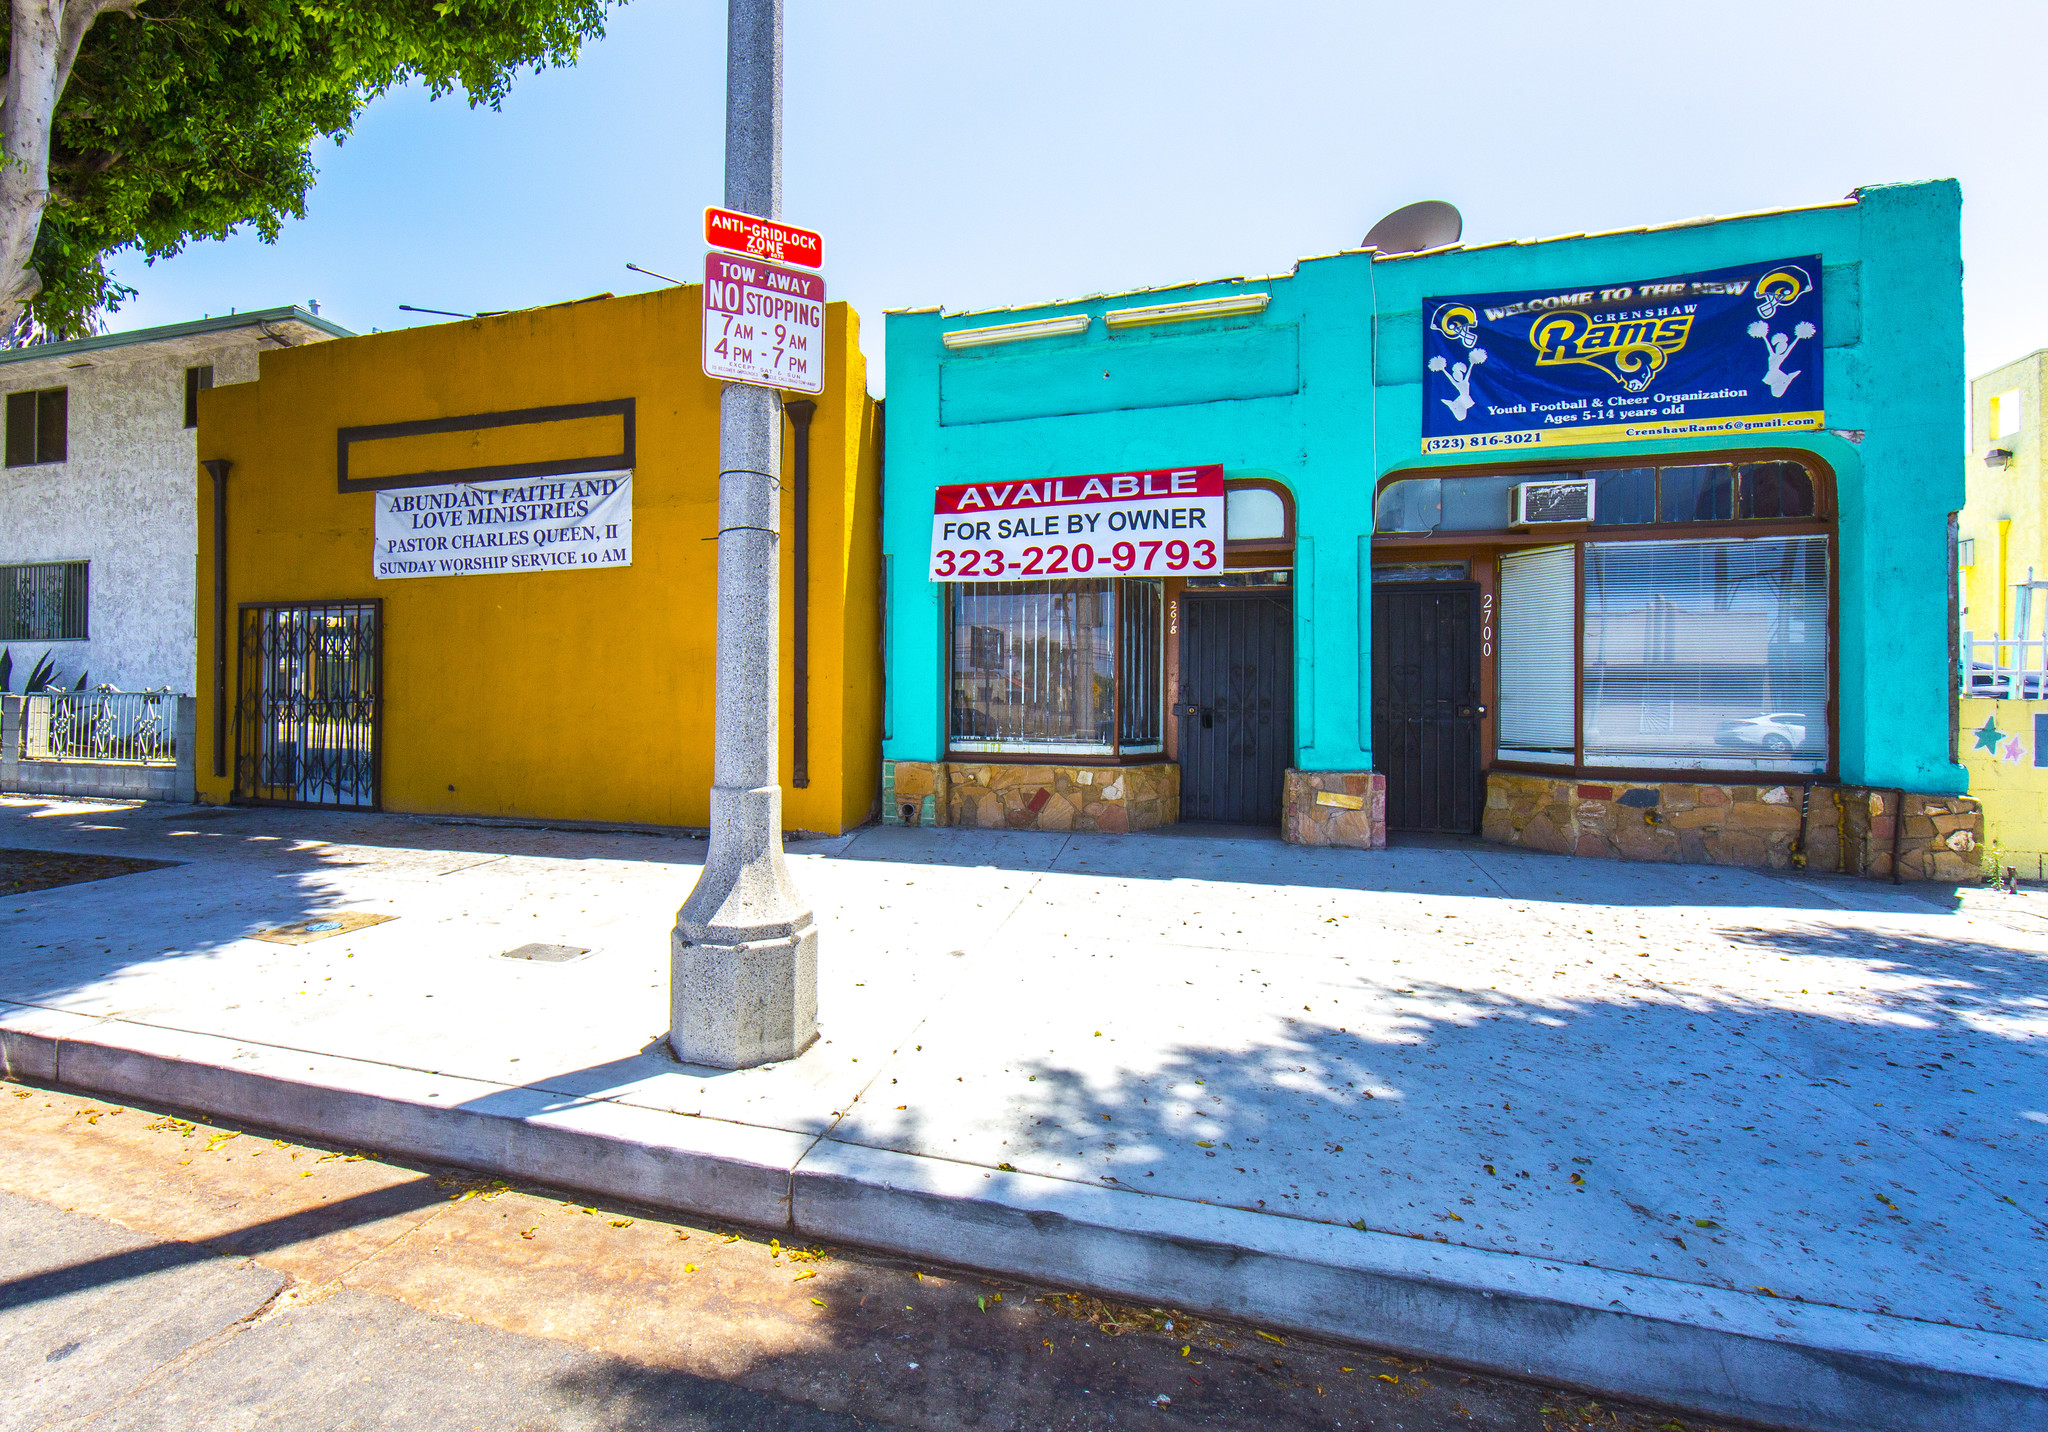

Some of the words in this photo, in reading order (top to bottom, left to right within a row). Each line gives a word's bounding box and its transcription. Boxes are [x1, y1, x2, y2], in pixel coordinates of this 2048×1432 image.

[711, 214, 817, 250] ANTI-GRIDLOCK
[746, 235, 785, 255] ZONE
[709, 279, 740, 312] NO
[746, 291, 820, 328] STOPPING
[1483, 291, 1595, 322] WELCOME
[1600, 287, 1633, 302] TO
[1638, 282, 1686, 298] THE
[1692, 281, 1751, 296] NEW
[1593, 304, 1698, 322] CRENSHAW
[720, 313, 734, 336] 7
[734, 323, 753, 341] AM
[774, 324, 786, 345] 9
[789, 334, 807, 352] AM
[1530, 310, 1695, 366] Rams
[714, 337, 728, 360] 4
[733, 346, 752, 364] PM
[772, 346, 785, 369] 7
[789, 356, 807, 374] PM
[729, 361, 756, 371] EXCEPT
[787, 372, 801, 380] SUN
[1488, 404, 1527, 415] Youth
[1530, 398, 1588, 413] Football
[1591, 398, 1604, 408] &
[1607, 393, 1650, 407] Cheer
[1653, 388, 1748, 404] Organization
[1544, 413, 1578, 425] Ages
[1582, 409, 1615, 421] 5-14
[1619, 408, 1658, 420] years
[1662, 404, 1685, 415] old
[1426, 438, 1465, 452] (323)
[1469, 432, 1542, 447] 816-3021
[1625, 417, 1815, 437] CrenshawRams6@gmail.com
[389, 490, 498, 513] ABUNDANT
[501, 482, 567, 505] FAITH
[569, 478, 618, 499] AND
[957, 470, 1198, 510] AVAILABLE
[412, 510, 463, 530] LOVE
[467, 500, 590, 526] MINISTRIES
[943, 521, 992, 541] FOR
[997, 515, 1059, 540] SALE
[1067, 512, 1101, 534] BY
[1108, 507, 1207, 532] OWNER
[388, 535, 449, 554] PASTOR
[451, 529, 530, 550] CHARLES
[533, 525, 600, 547] QUEEN,
[605, 524, 619, 540] II
[379, 559, 437, 575] SUNDAY
[440, 555, 509, 573] WORSHIP
[511, 551, 577, 568] SERVICE
[580, 552, 597, 564] 10
[601, 548, 627, 562] AM
[935, 539, 1217, 577] 323-220-9793
[1483, 594, 1493, 657] 2700
